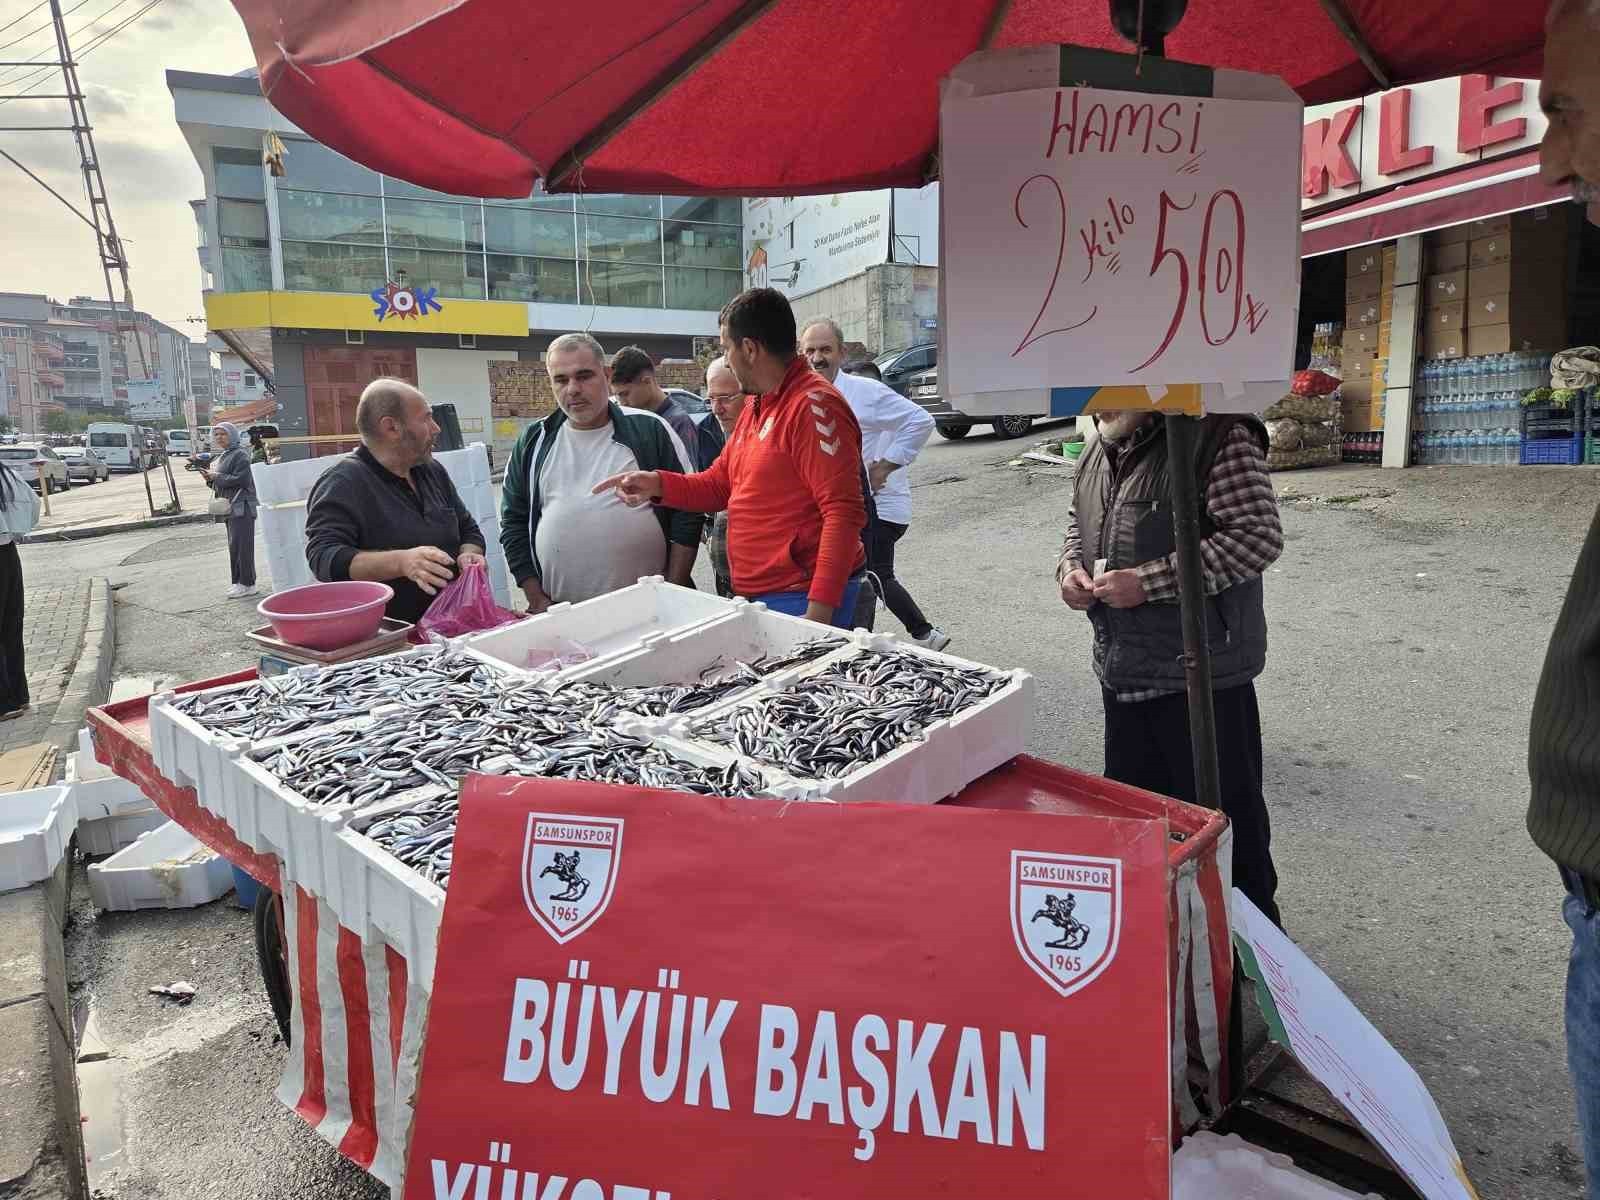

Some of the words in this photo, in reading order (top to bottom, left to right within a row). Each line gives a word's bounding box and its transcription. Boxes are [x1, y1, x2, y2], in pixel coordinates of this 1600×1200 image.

[1011, 174, 1098, 357] 2
[536, 825, 612, 843] SAMSUNSPOR
[1022, 864, 1109, 885] SAMSUNSPOR
[550, 905, 579, 922] 1965
[1048, 953, 1082, 972] 1965
[503, 959, 739, 1111] BÜYÜK
[753, 1003, 1046, 1161] BAŞKAN
